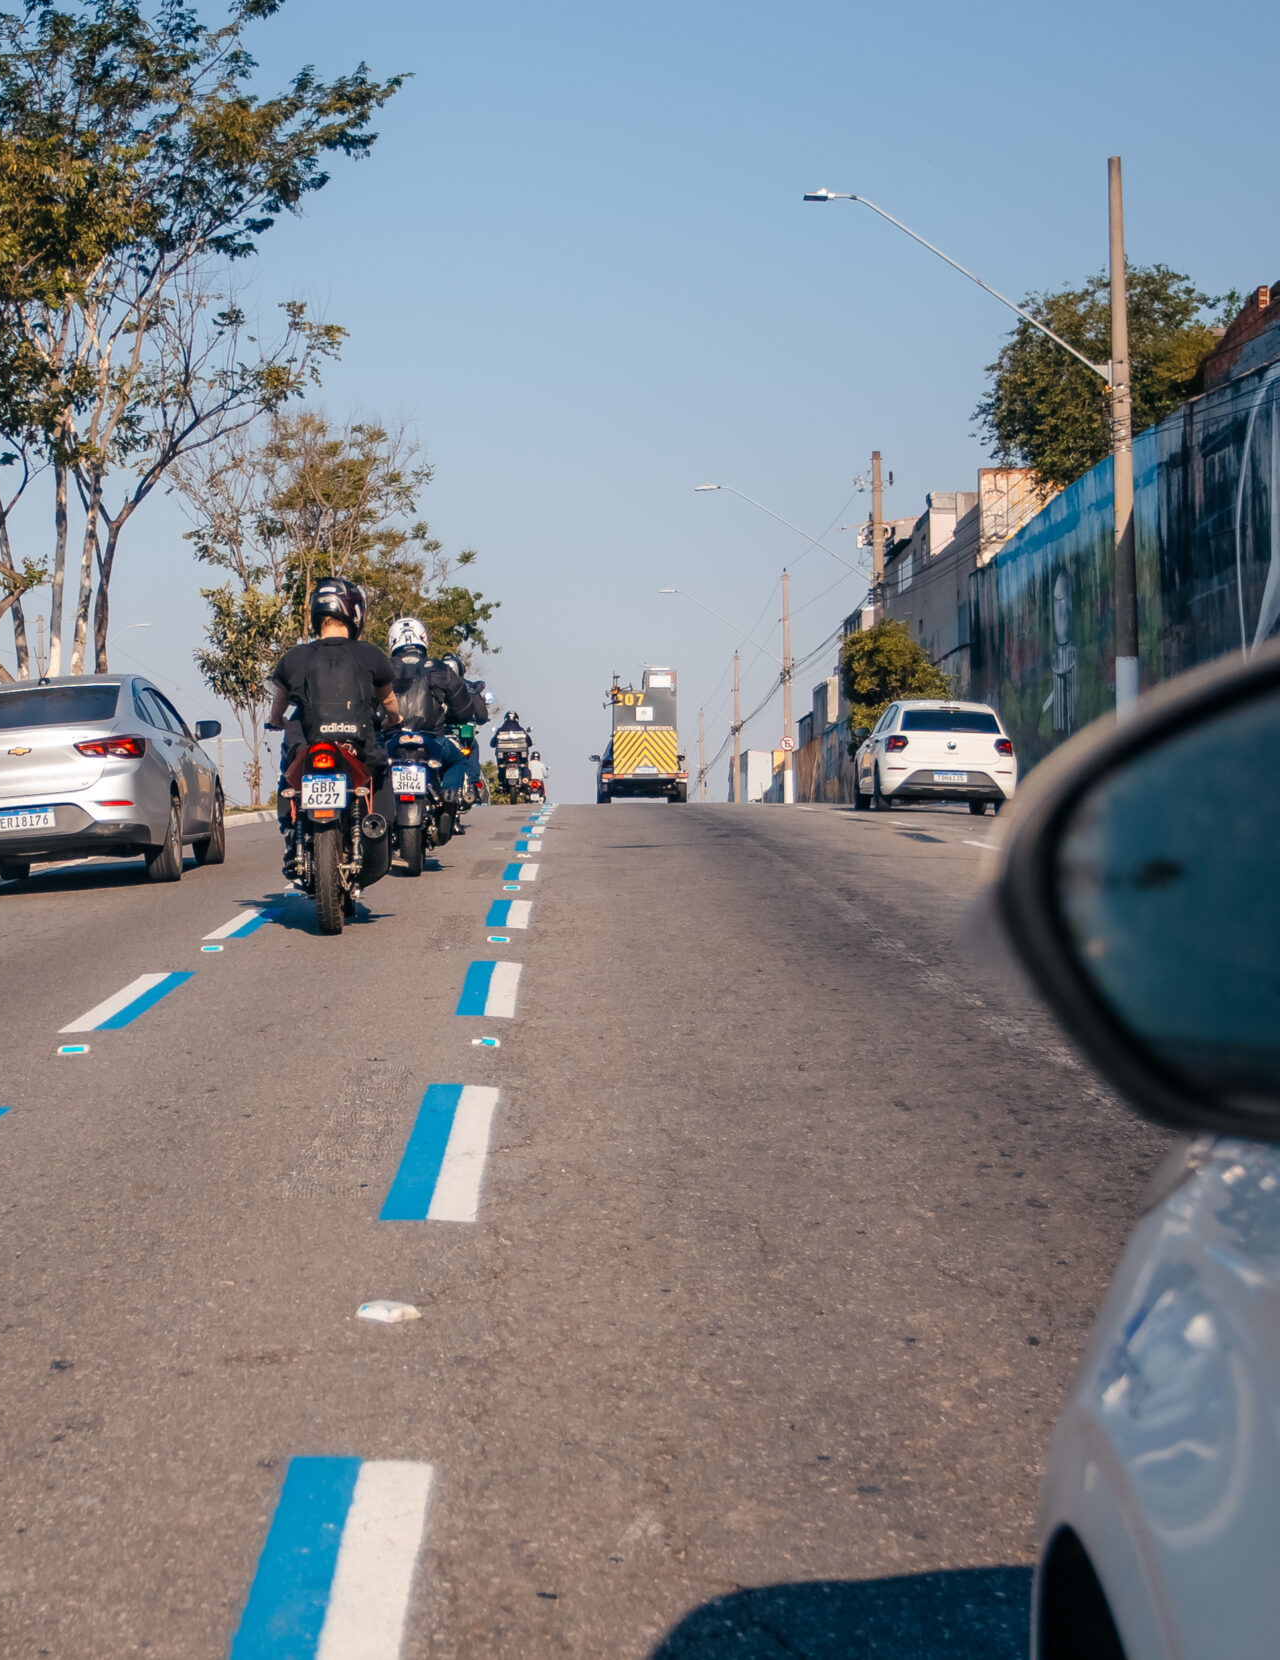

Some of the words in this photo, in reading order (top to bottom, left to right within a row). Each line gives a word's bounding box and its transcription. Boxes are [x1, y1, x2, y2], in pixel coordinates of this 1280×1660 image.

[319, 722, 358, 733] adidas
[399, 772, 419, 782] GGJ
[311, 782, 336, 794] GBR
[396, 781, 421, 791] 3H44
[307, 793, 340, 805] 6C27
